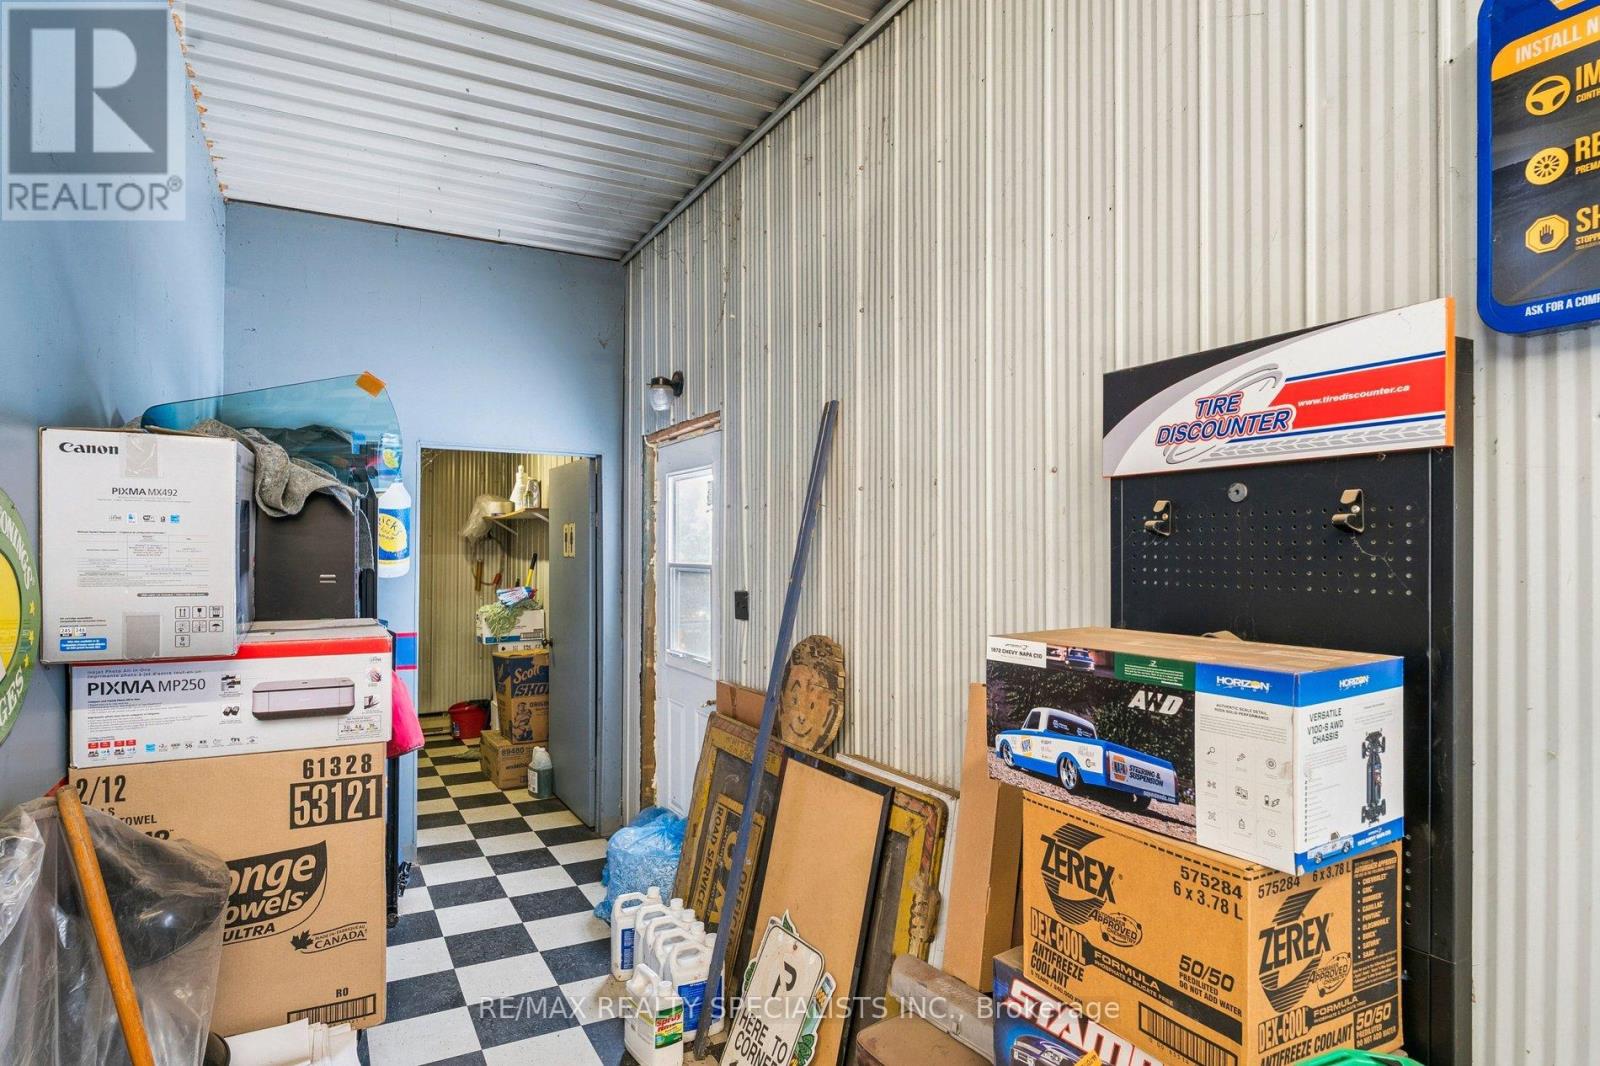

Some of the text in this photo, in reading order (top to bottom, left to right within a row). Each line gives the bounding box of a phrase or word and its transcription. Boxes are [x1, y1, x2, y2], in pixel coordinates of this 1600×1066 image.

[1516, 25, 1582, 65] INSTALL
[1525, 304, 1544, 317] ASK
[1546, 299, 1564, 313] FOR
[1566, 297, 1574, 309] A
[1196, 393, 1242, 417] TIRE
[1297, 384, 1410, 407] www.tirediscounter.ca
[1157, 409, 1291, 445] DISCOUNTER
[59, 442, 119, 455] Canon
[111, 486, 178, 497] PIXMA MX492
[1002, 648, 1018, 656] CHEVY
[513, 664, 540, 685] Scott
[1216, 676, 1270, 691] HORIZON
[1339, 675, 1369, 688] HORIZON
[87, 678, 206, 696] PIXMA MP250
[514, 683, 549, 696] SHO
[1128, 690, 1183, 715] AWD
[1216, 703, 1239, 711] AUTHENTIC
[1239, 711, 1269, 720] PERFORMANCE
[1310, 708, 1342, 722] VERSATILE
[1307, 720, 1344, 735] V100-S AWD
[1312, 731, 1339, 745] CHASSIS
[303, 753, 372, 779] 61328
[1129, 765, 1155, 777] STEERING
[1129, 772, 1163, 786] SUSPENSION
[294, 778, 376, 826] 53121
[697, 806, 723, 908] ROAD SERVICE
[1041, 834, 1116, 904] ZEREX
[1312, 871, 1317, 882] 6
[1319, 872, 1324, 880] x
[1326, 863, 1344, 879] 3.78
[1346, 861, 1351, 872] L
[1180, 865, 1243, 900] 575284
[1258, 876, 1300, 899] 575284
[1173, 881, 1243, 921] 6 x 3.78 L
[1363, 901, 1383, 912] CADILLAC
[1088, 909, 1138, 941] APPROVED
[1363, 911, 1381, 921] PONTIAC
[223, 922, 275, 942] ULTRA
[314, 930, 365, 949] CANADA
[1031, 908, 1086, 965] DEX-COOL
[1259, 913, 1332, 975] ZEREX
[1031, 954, 1069, 988] COOLANT
[1032, 941, 1084, 982] ANTIFREEZE
[1095, 959, 1126, 981] PHOSPHATE
[1095, 950, 1160, 991] FORMULA
[1179, 954, 1235, 992] 50/50
[771, 961, 797, 997] P
[1035, 971, 1049, 986] YEARS
[1179, 972, 1218, 996] PREDILUTED
[1307, 965, 1347, 985] APPROVED
[1179, 980, 1242, 1017] DO NOT ADD WATER
[1314, 996, 1358, 1017] FORMULA
[1357, 1003, 1391, 1031] 50/50
[739, 1008, 788, 1063] HERE TO
[1259, 1006, 1309, 1054] DEX-COOL
[735, 1031, 777, 1066] CORNE
[1260, 1023, 1353, 1066] ANTIFREEZE COOLANT
